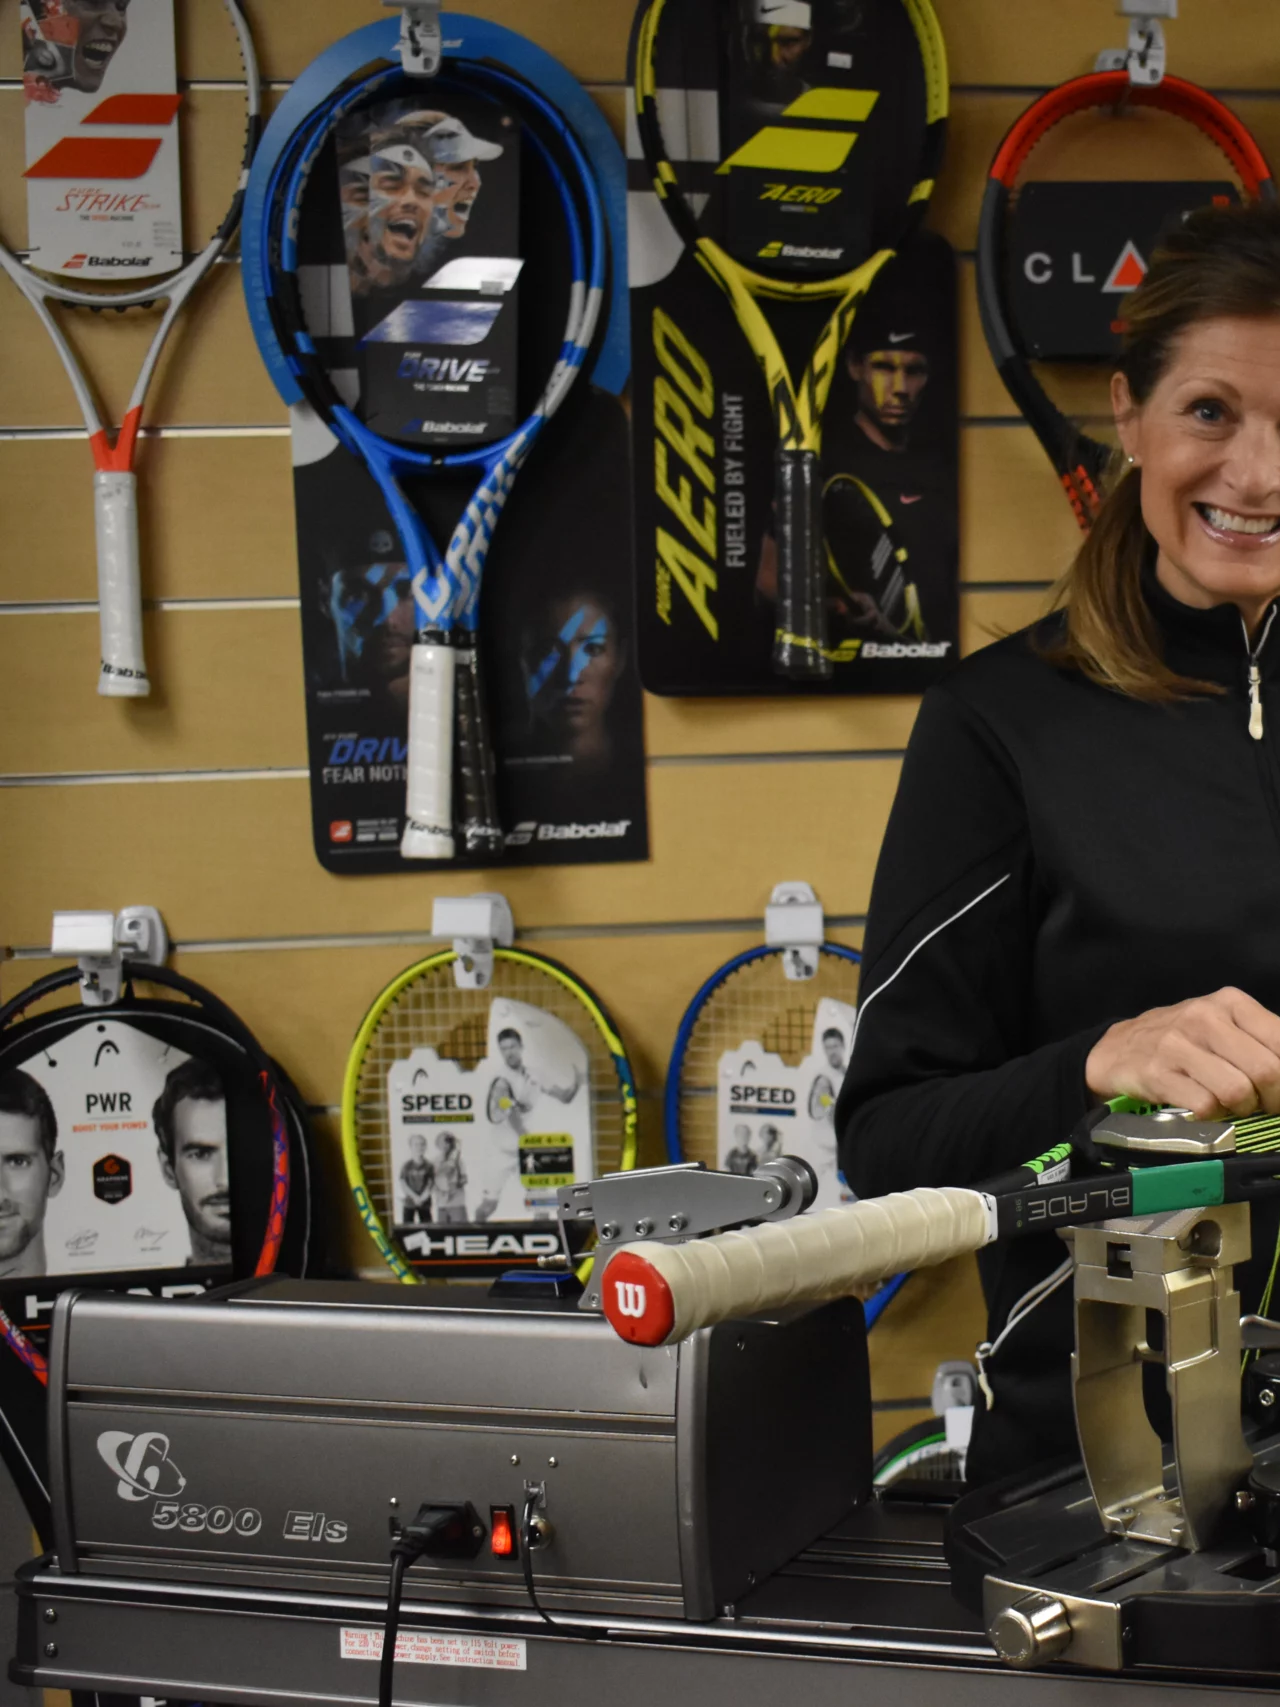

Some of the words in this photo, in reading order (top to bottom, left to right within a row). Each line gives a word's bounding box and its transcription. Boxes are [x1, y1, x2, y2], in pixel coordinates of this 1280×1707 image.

[55, 193, 151, 212] STRIKE
[757, 183, 843, 204] AERO
[88, 256, 153, 267] Babolat
[781, 244, 845, 260] Babolat
[1024, 240, 1149, 293] CLA
[397, 357, 491, 382] DRIVE
[421, 420, 489, 434] Babolat
[722, 392, 743, 453] FIGHT
[652, 305, 719, 642] AERO
[724, 457, 745, 486] BY
[725, 491, 746, 568] FUELED
[861, 641, 951, 659] Babolat
[328, 737, 408, 765] DRIV
[322, 765, 365, 784] FEAR
[368, 764, 407, 782] NOT
[538, 820, 632, 841] Babolat
[86, 1092, 133, 1114] PWR
[402, 1093, 472, 1111] SPEED
[730, 1085, 796, 1104] SPEED
[1028, 1187, 1130, 1221] BLADE
[421, 1233, 560, 1257] HEAD
[615, 1280, 646, 1318] W
[152, 1501, 262, 1537] 5800
